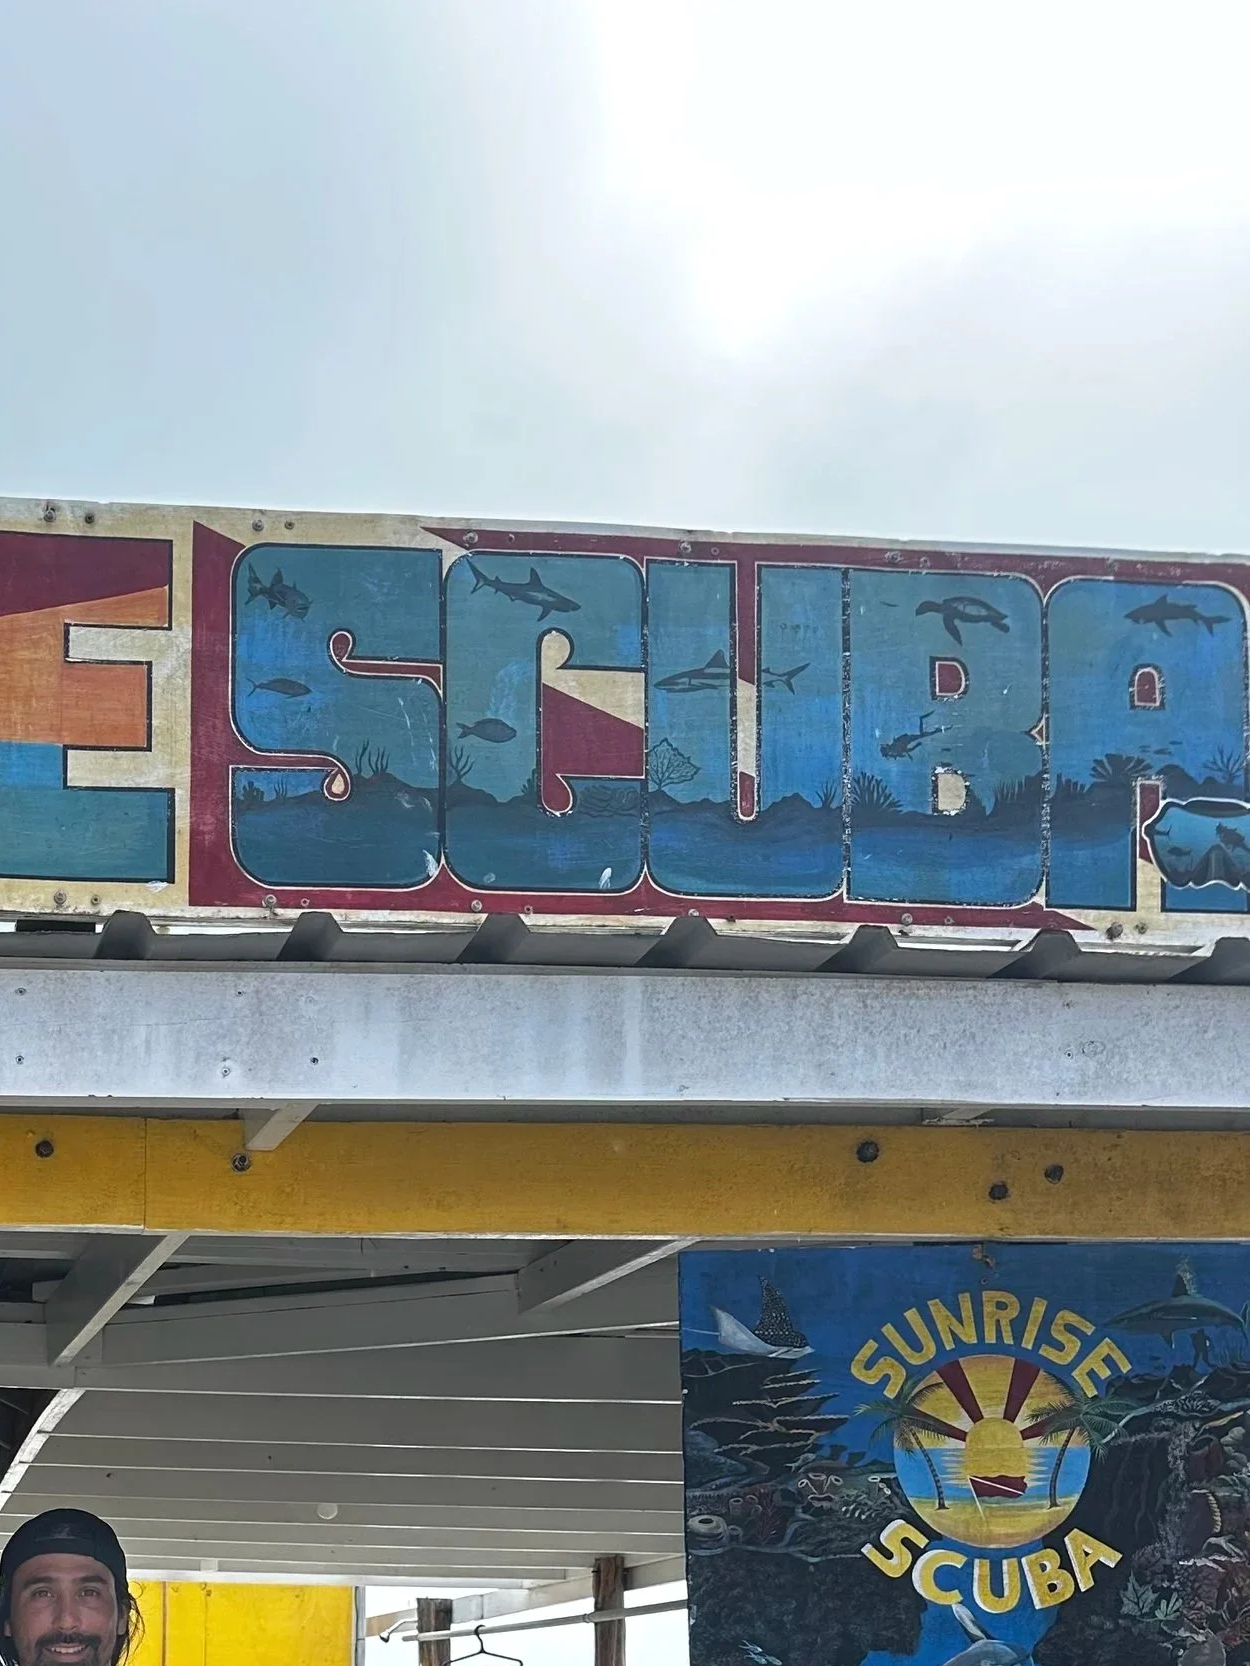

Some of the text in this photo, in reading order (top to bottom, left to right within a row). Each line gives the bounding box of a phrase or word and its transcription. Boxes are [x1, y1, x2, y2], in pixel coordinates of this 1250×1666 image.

[229, 541, 1250, 914] SCUBA
[850, 1290, 1133, 1400] SUNRISE
[861, 1518, 1123, 1614] SCUBA
